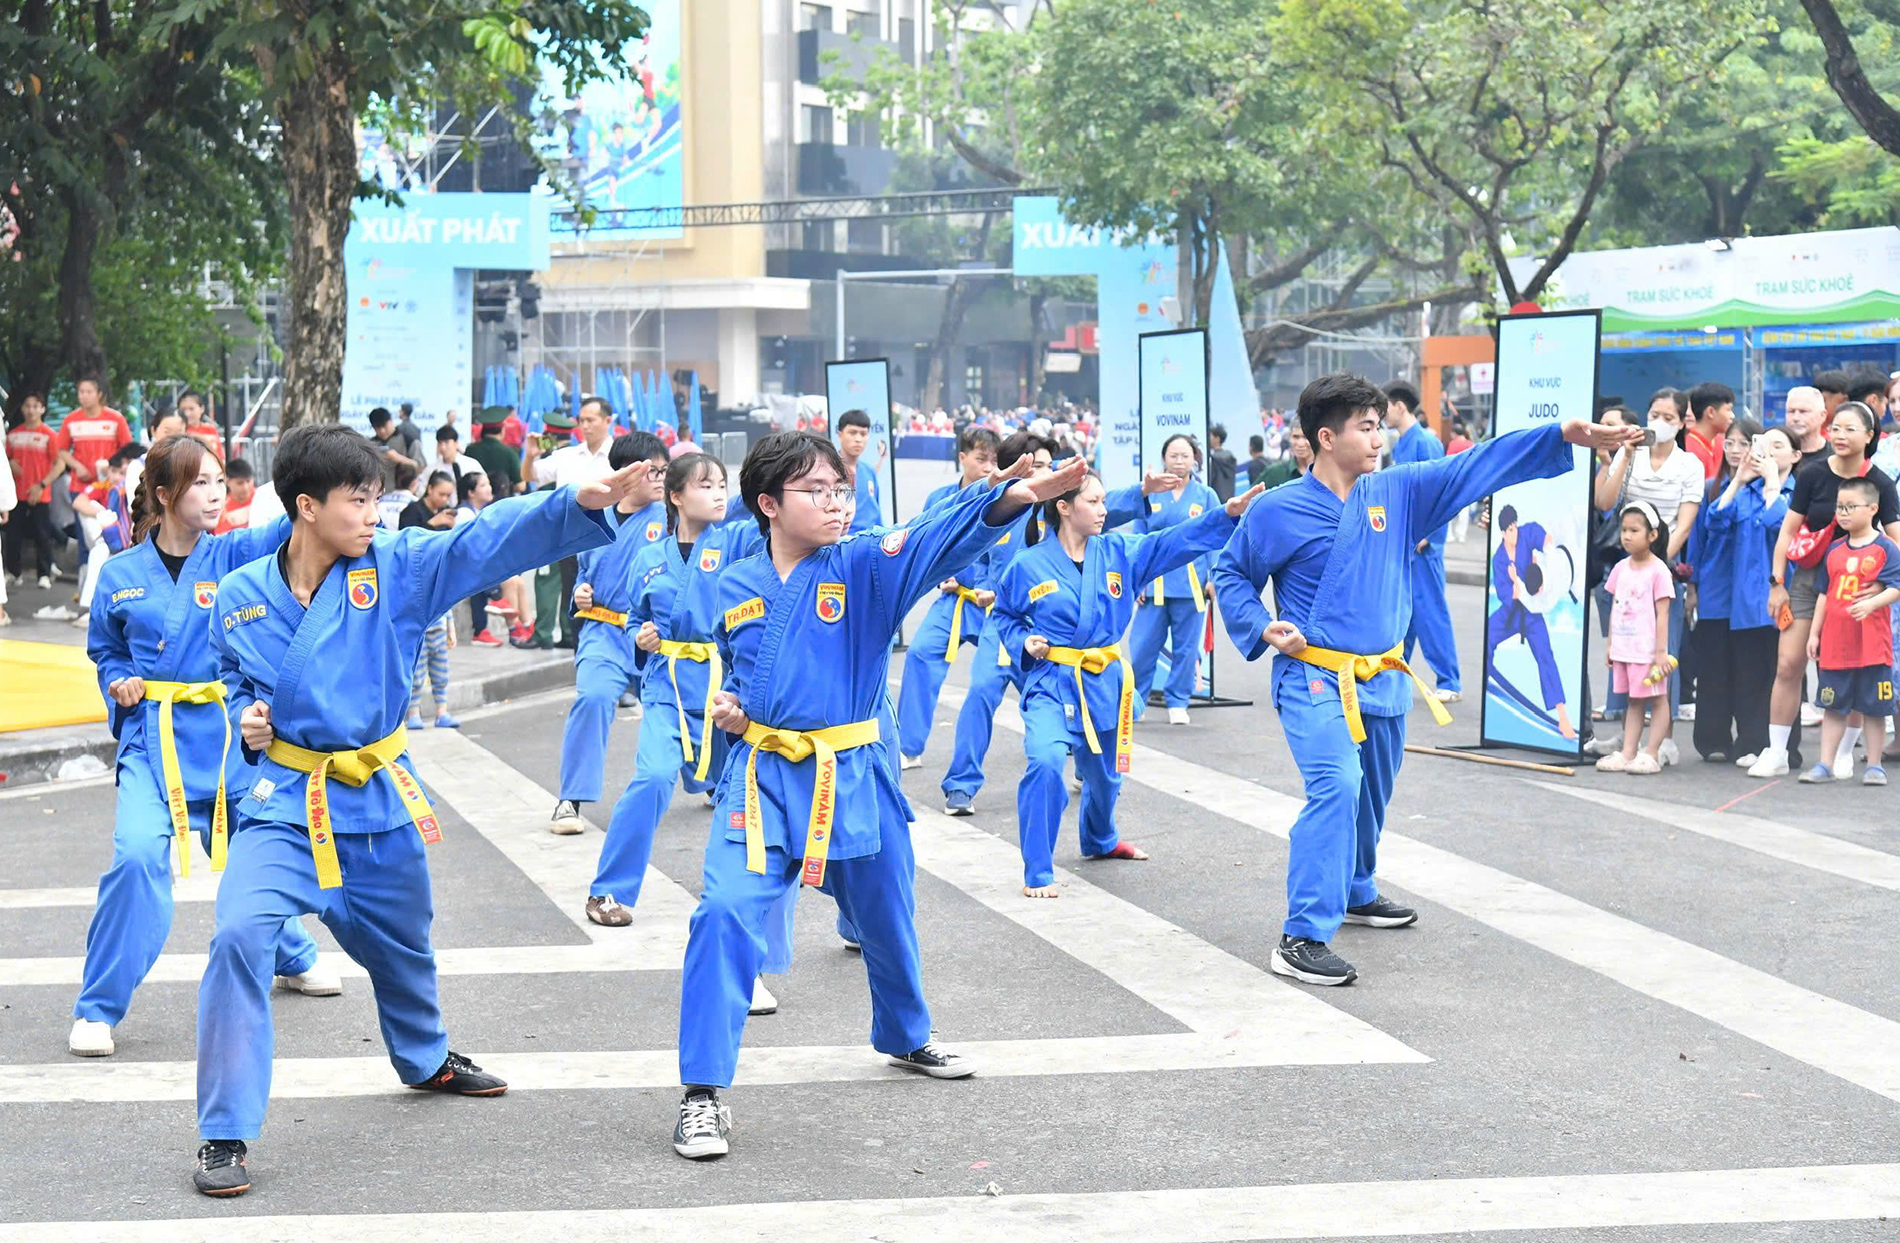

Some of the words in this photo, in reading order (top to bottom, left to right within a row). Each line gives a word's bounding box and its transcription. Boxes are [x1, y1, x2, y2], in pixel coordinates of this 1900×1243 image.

[360, 208, 438, 244] XUẤT
[442, 212, 522, 244] PHÁT
[1156, 414, 1190, 426] VOVINAM
[1529, 403, 1559, 418] JUDO
[1836, 574, 1859, 600] 19
[1877, 680, 1894, 701] 19
[1121, 691, 1132, 735] VOVINAM
[815, 759, 834, 825] VOVINAM
